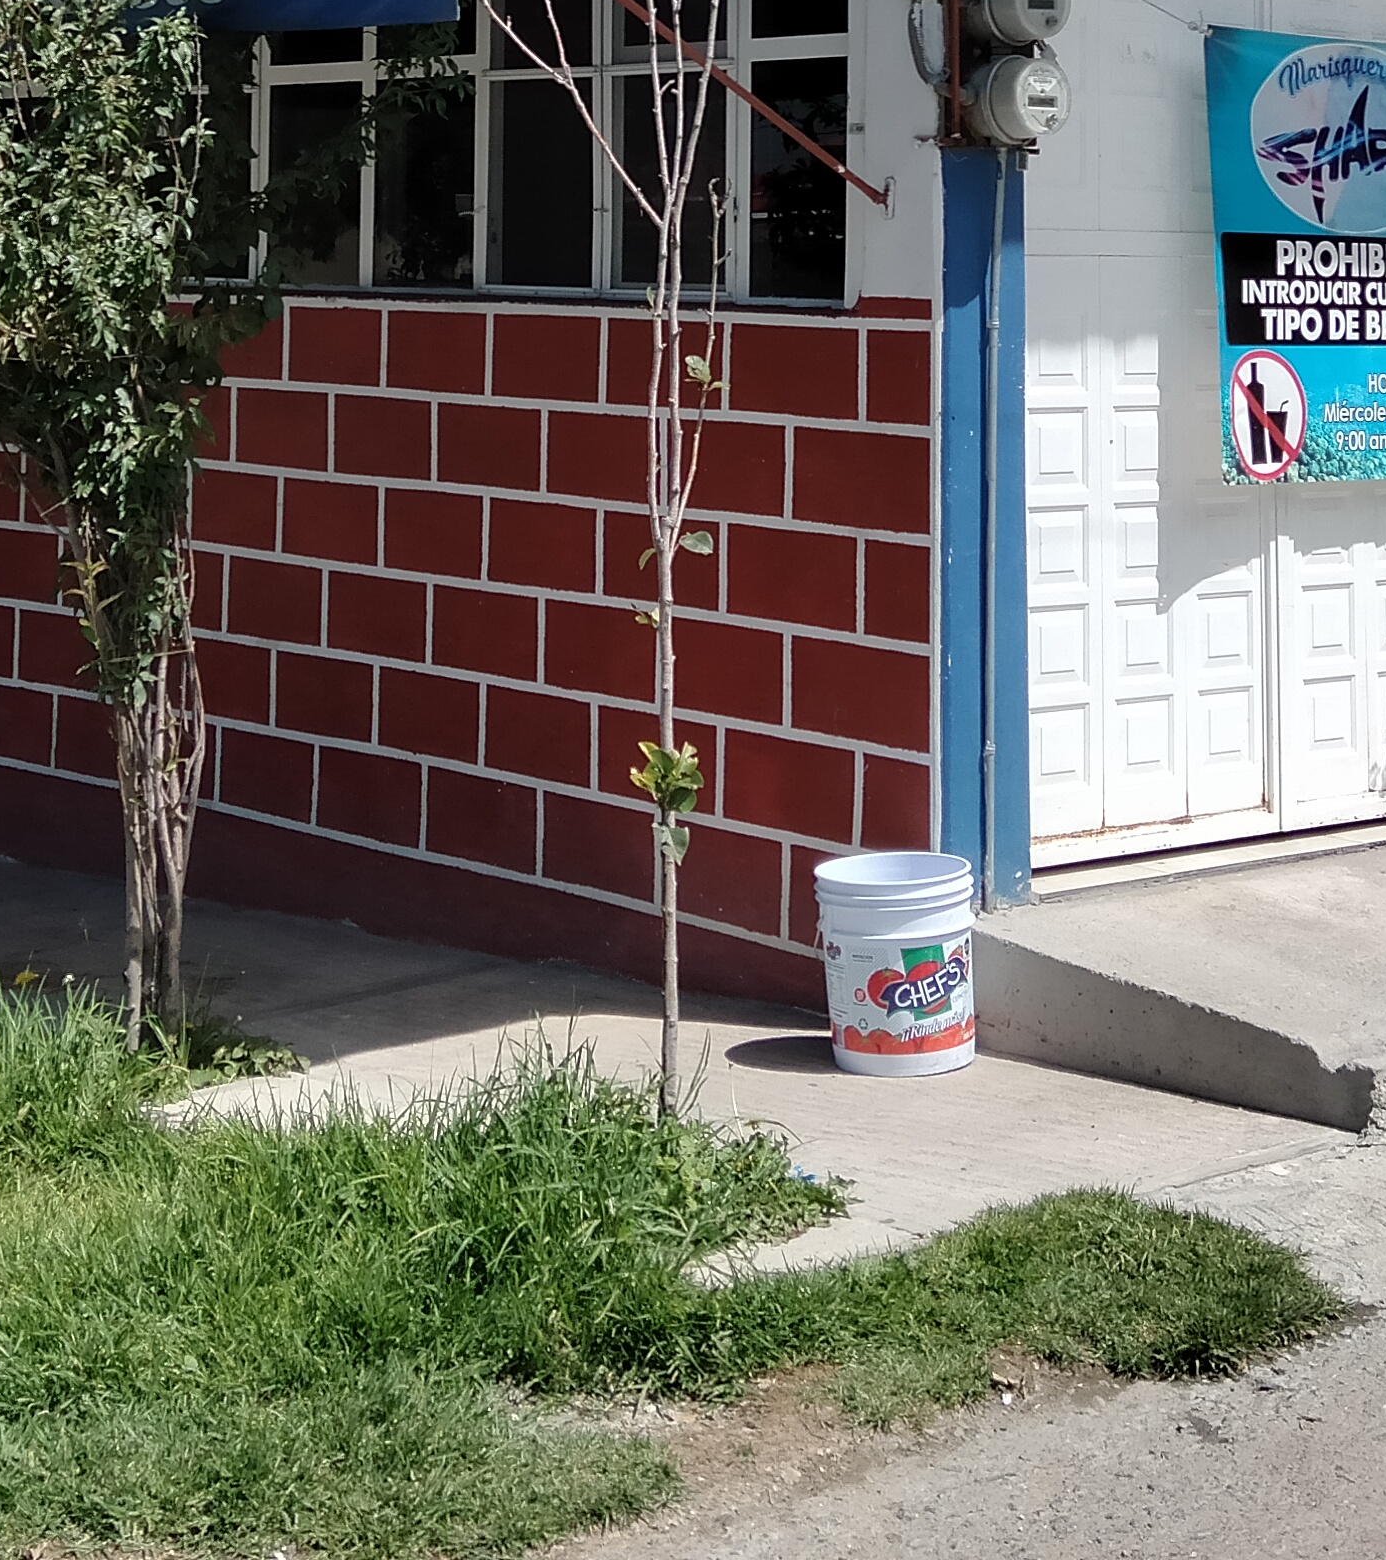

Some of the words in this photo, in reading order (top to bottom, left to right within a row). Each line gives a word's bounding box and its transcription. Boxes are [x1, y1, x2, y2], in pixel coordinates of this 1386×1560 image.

[1242, 279, 1362, 305] INTRODUCIR
[1261, 308, 1323, 340] TIPO
[1329, 309, 1360, 340] DE
[1336, 430, 1365, 451] 9:00
[894, 962, 961, 1008] CHEF'S
